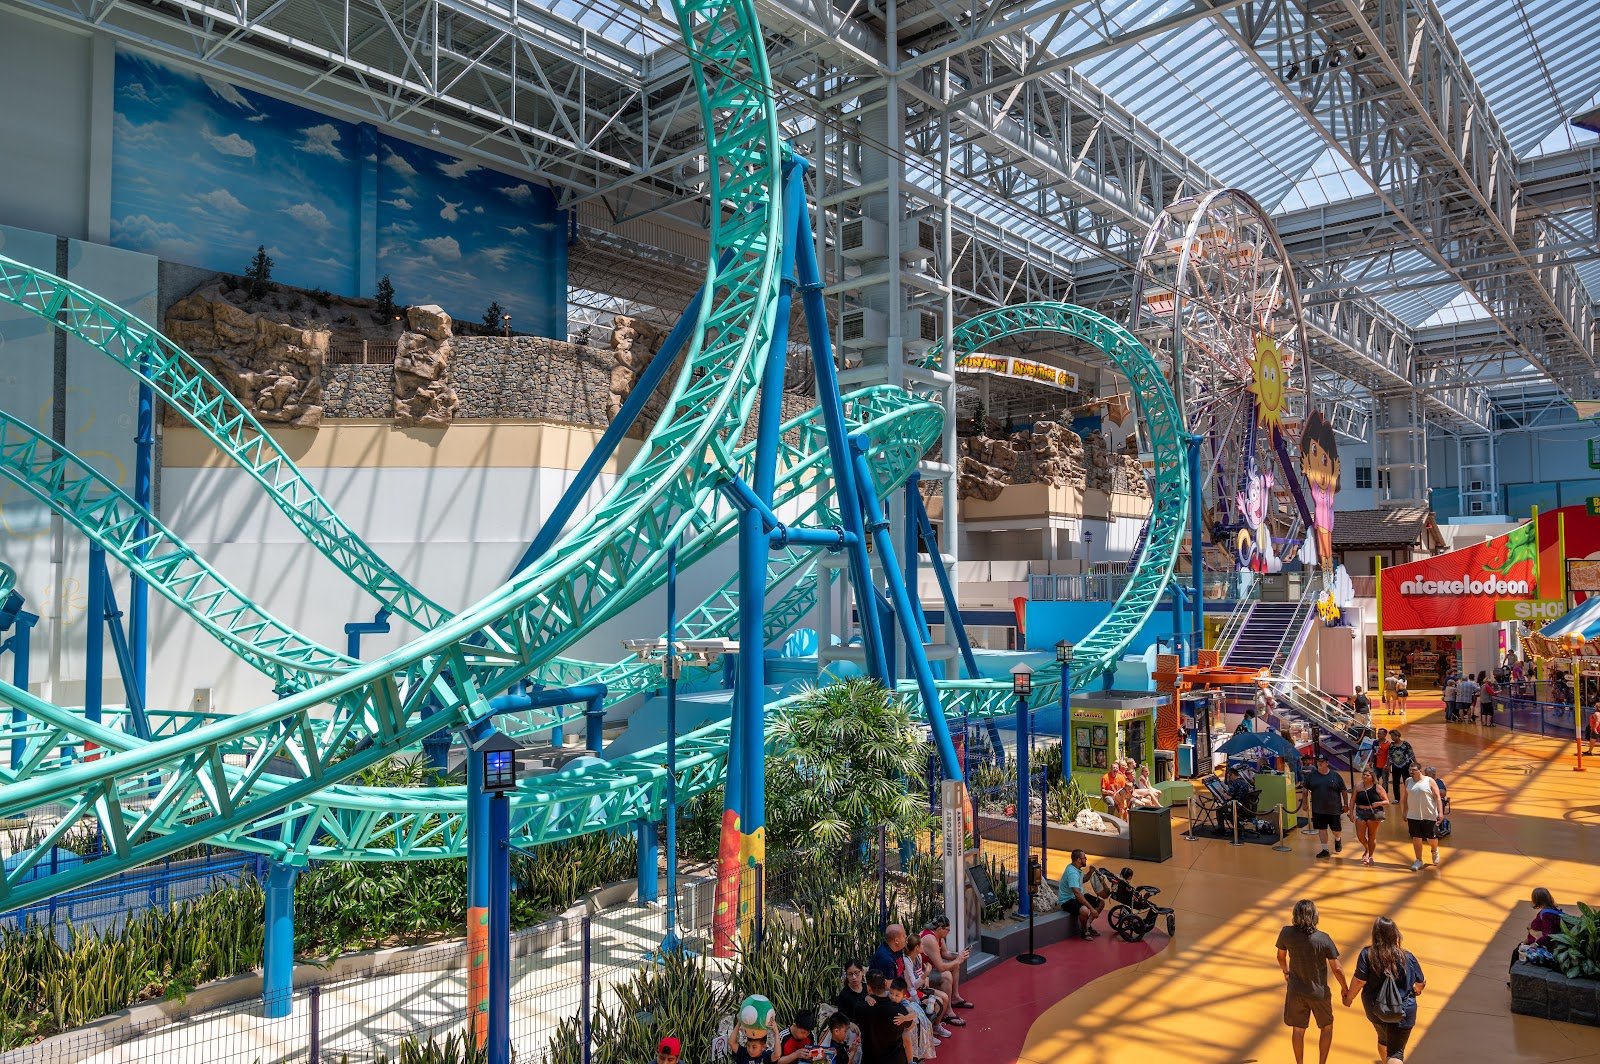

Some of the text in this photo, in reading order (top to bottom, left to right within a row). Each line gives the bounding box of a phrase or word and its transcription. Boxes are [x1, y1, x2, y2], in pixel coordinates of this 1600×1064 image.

[1013, 360, 1056, 382] ADVENTURE
[1400, 574, 1528, 595] nickelodeon
[1514, 602, 1564, 618] SHOP
